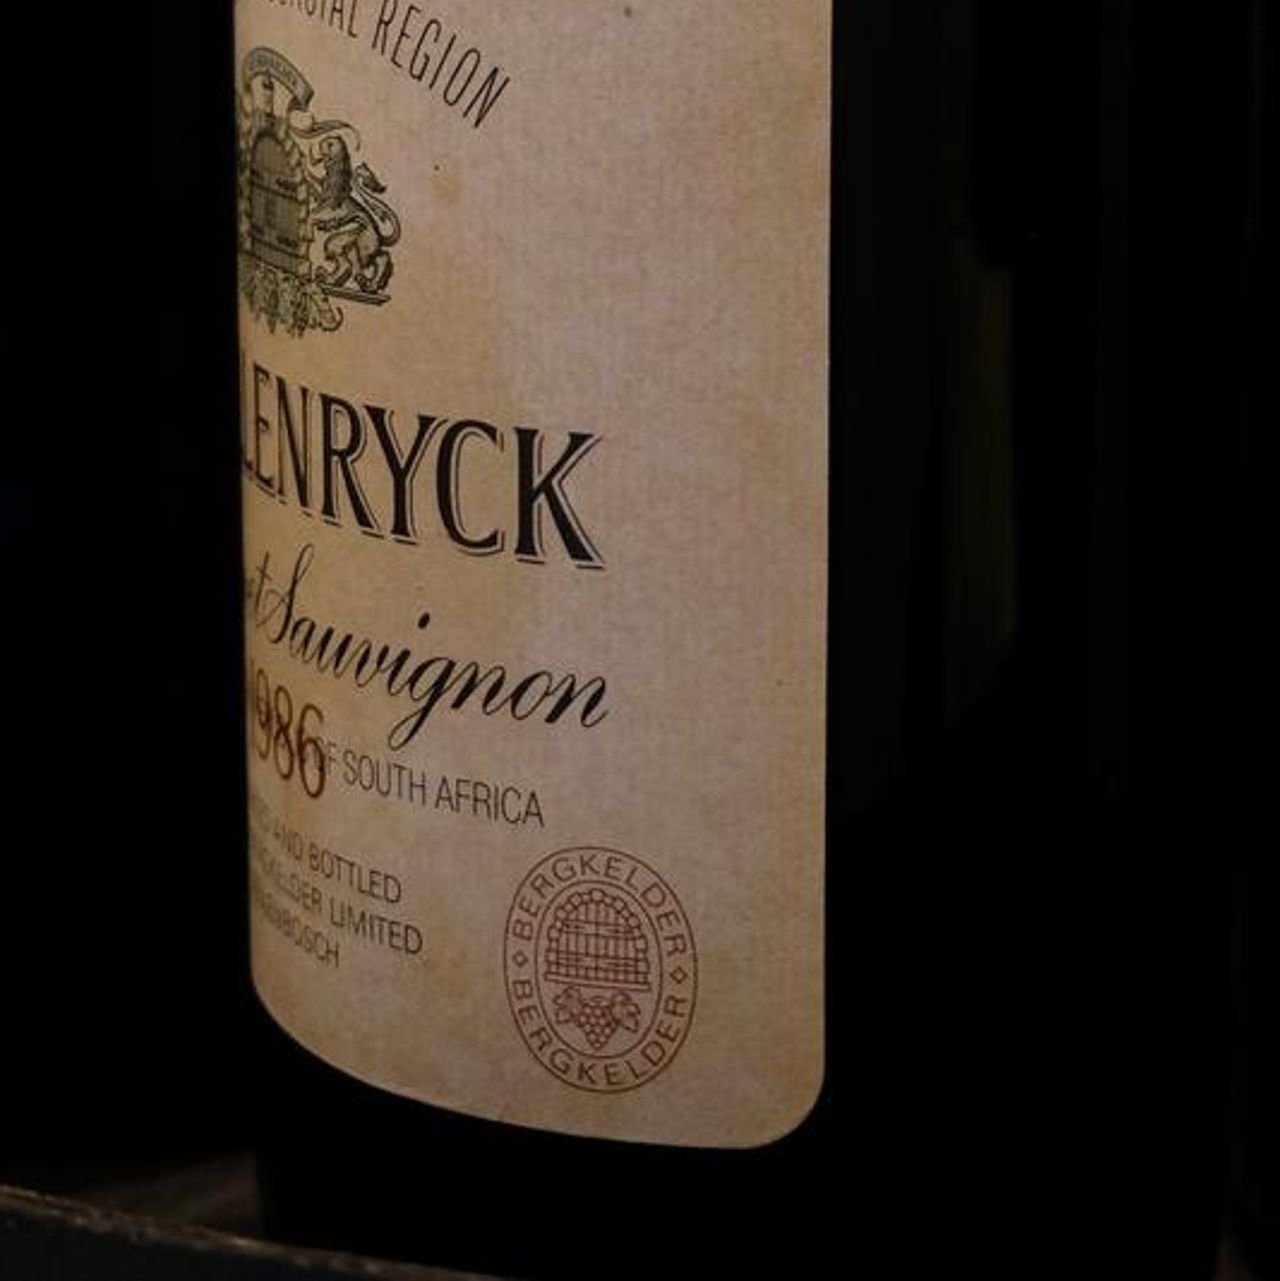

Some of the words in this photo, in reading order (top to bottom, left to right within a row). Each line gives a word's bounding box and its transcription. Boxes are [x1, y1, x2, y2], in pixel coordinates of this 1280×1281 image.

[244, 360, 606, 570] ENRYCK
[256, 543, 610, 751] Sauvignon
[250, 664, 328, 800] 986
[342, 747, 427, 807] SOUTH
[434, 776, 546, 828] AFRICA
[308, 841, 403, 904] BOTTLED
[329, 895, 424, 956] LIMITED
[512, 853, 688, 957] BERGKELDER
[512, 978, 689, 1086] BERGKELDER
